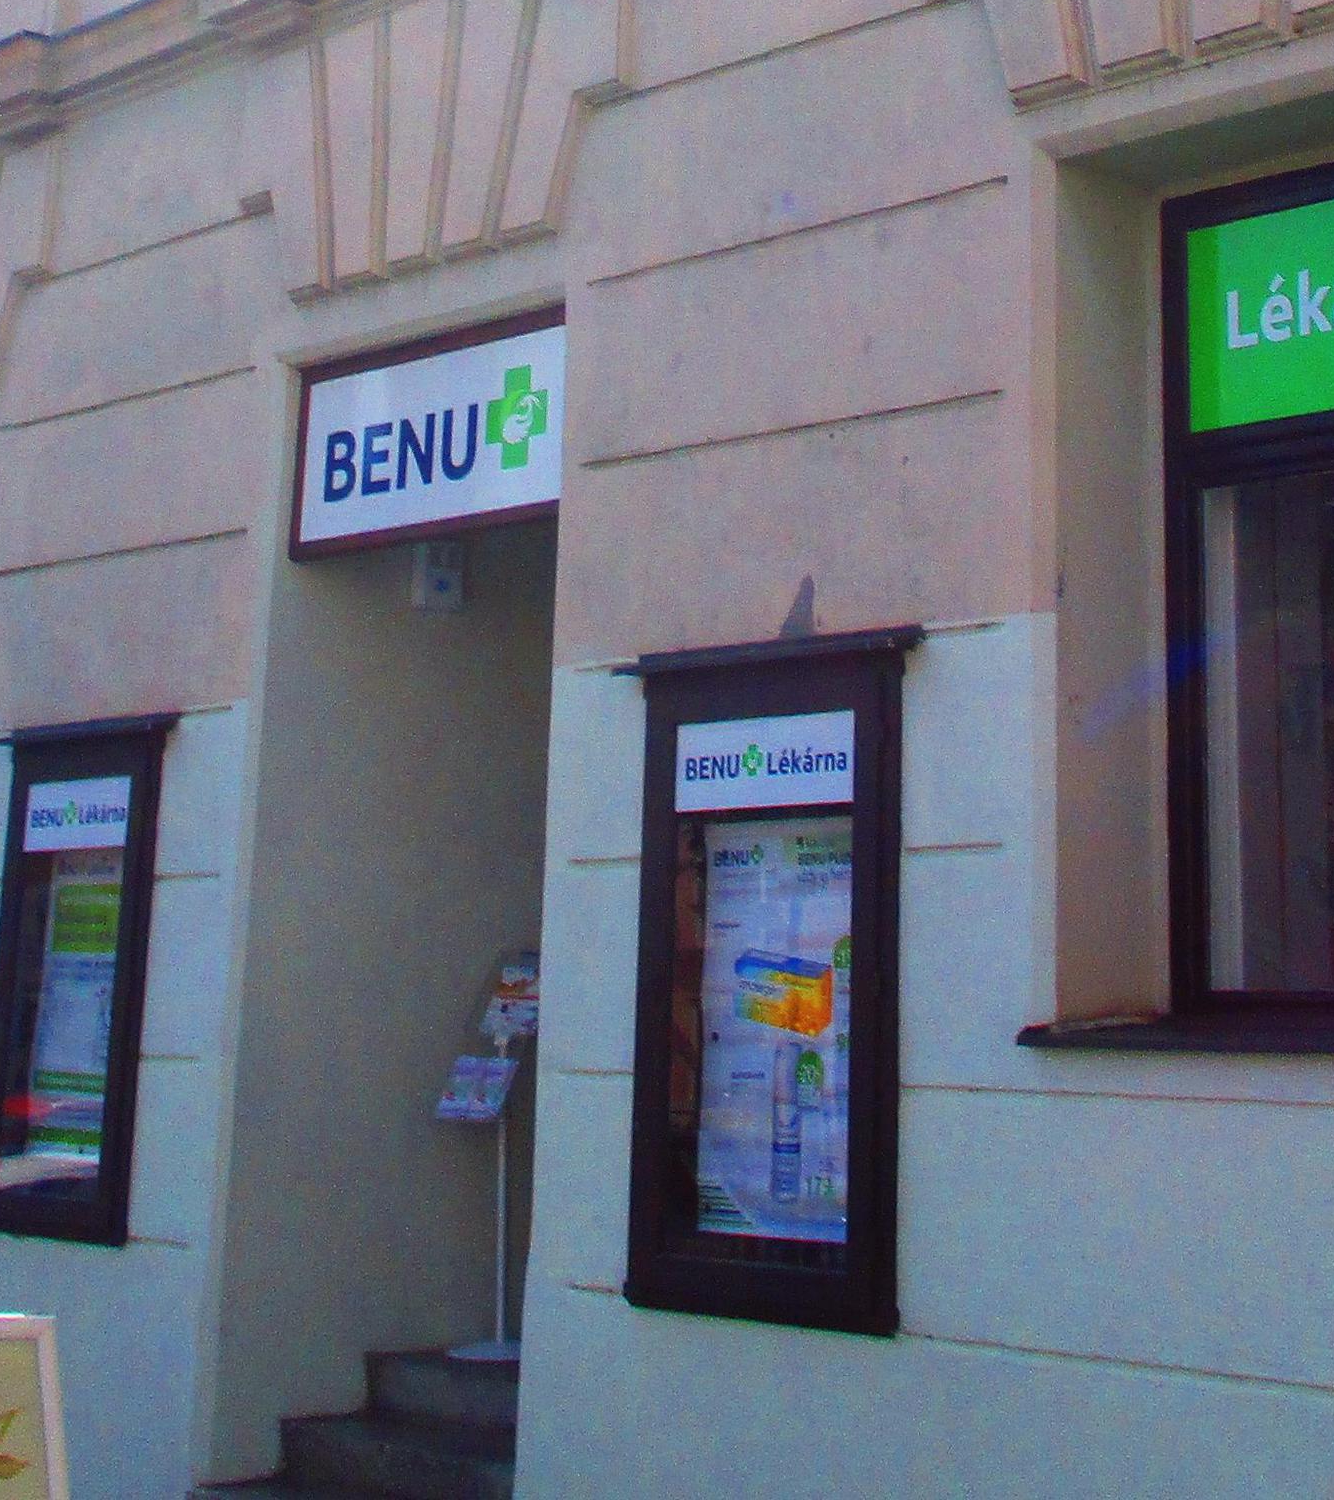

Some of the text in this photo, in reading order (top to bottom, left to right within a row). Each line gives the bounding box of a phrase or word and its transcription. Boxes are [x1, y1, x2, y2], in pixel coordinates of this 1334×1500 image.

[324, 403, 479, 503] BENU
[684, 746, 848, 781] BENU Lékárna
